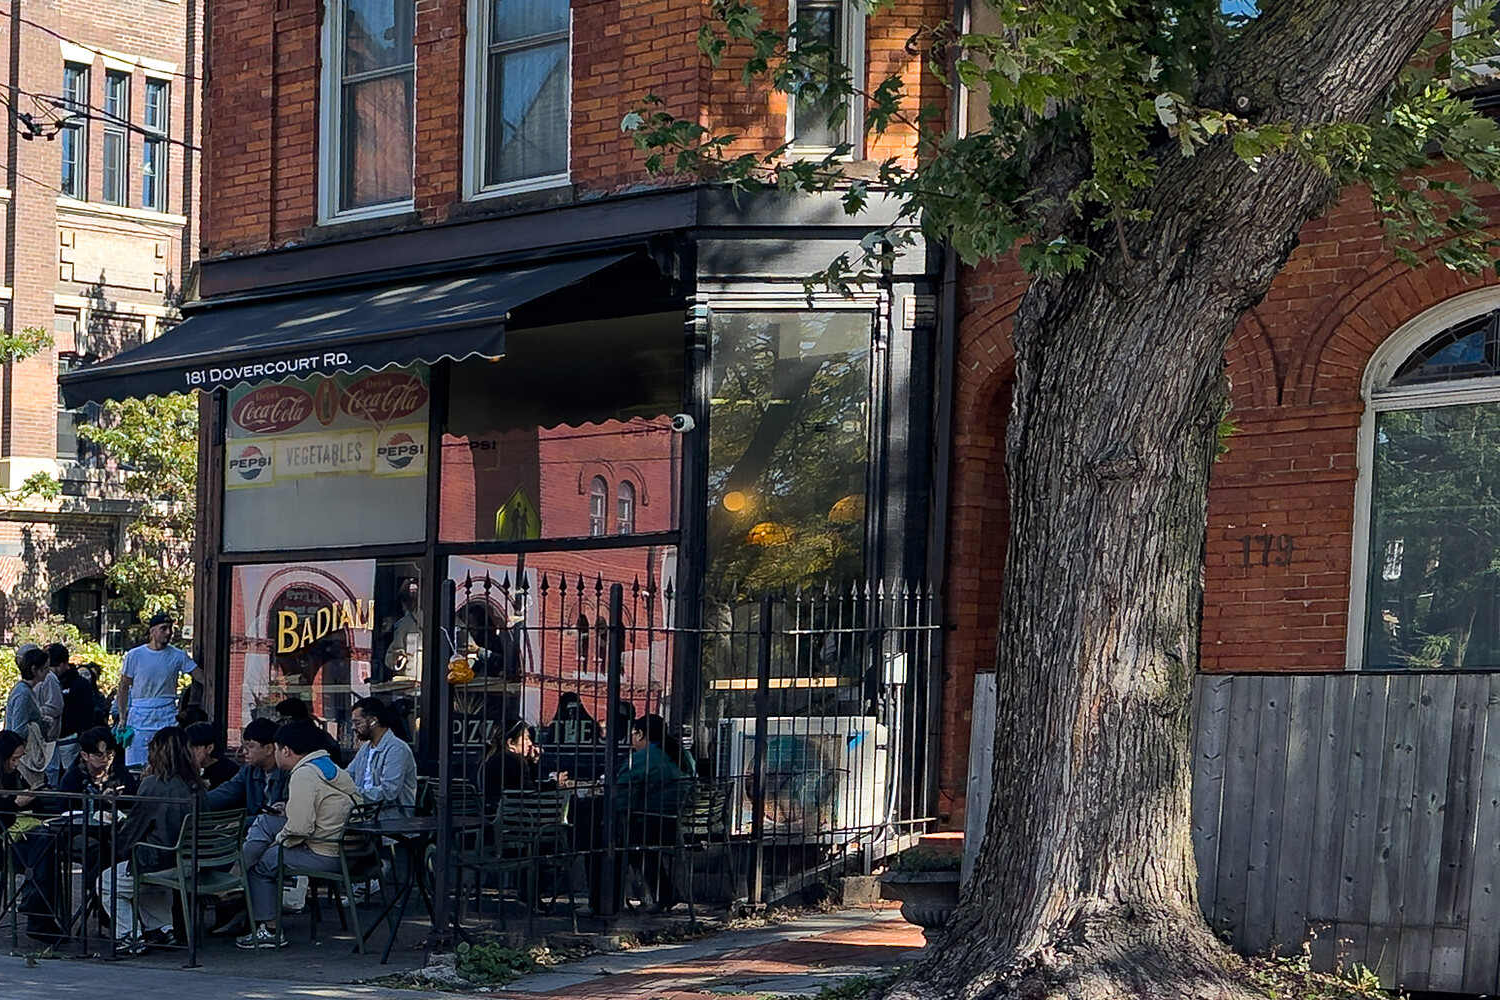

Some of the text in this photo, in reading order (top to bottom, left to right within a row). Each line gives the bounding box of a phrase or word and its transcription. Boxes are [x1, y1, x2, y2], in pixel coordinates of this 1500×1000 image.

[185, 352, 352, 385] 181 DOVERCOURT RD.
[229, 455, 272, 470] PEPSI
[286, 441, 362, 467] VEGETABLES
[376, 443, 425, 458] PEPSI
[1238, 533, 1295, 569] 179
[277, 598, 375, 655] BADIALI
[453, 719, 496, 744] PIZZ
